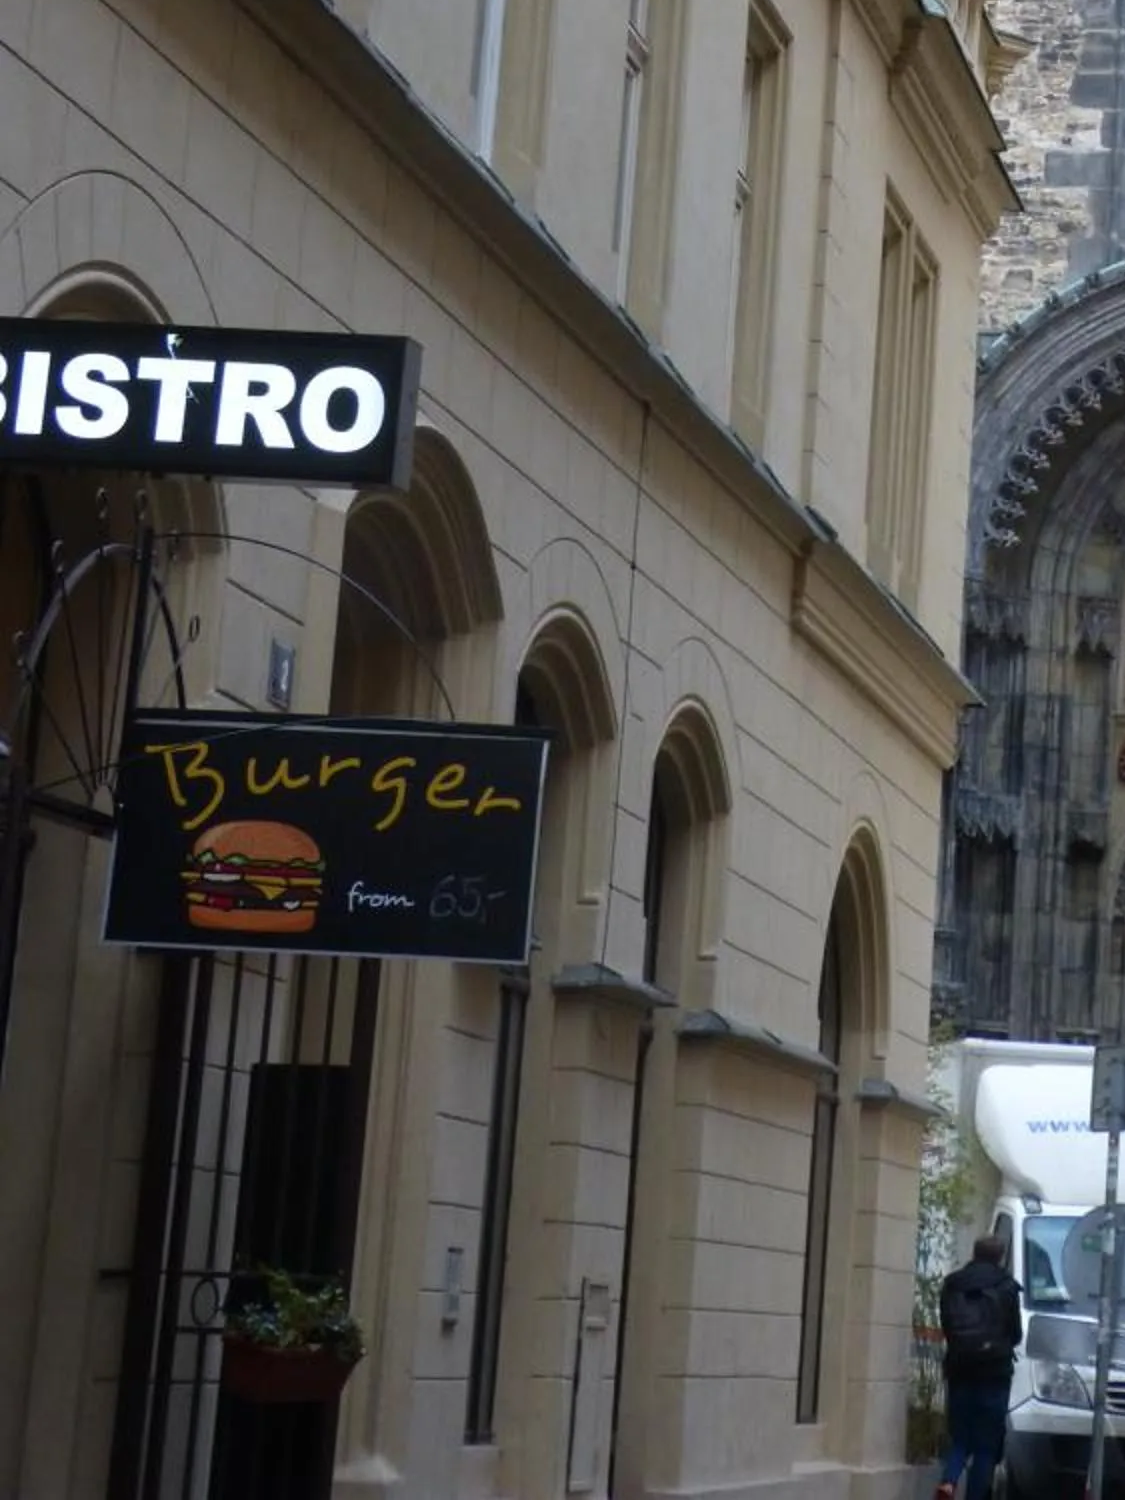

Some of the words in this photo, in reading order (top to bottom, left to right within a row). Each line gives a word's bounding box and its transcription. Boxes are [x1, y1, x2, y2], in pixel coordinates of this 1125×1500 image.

[0, 351, 386, 453] ISTRO
[145, 742, 522, 830] Burger
[347, 880, 416, 913] from
